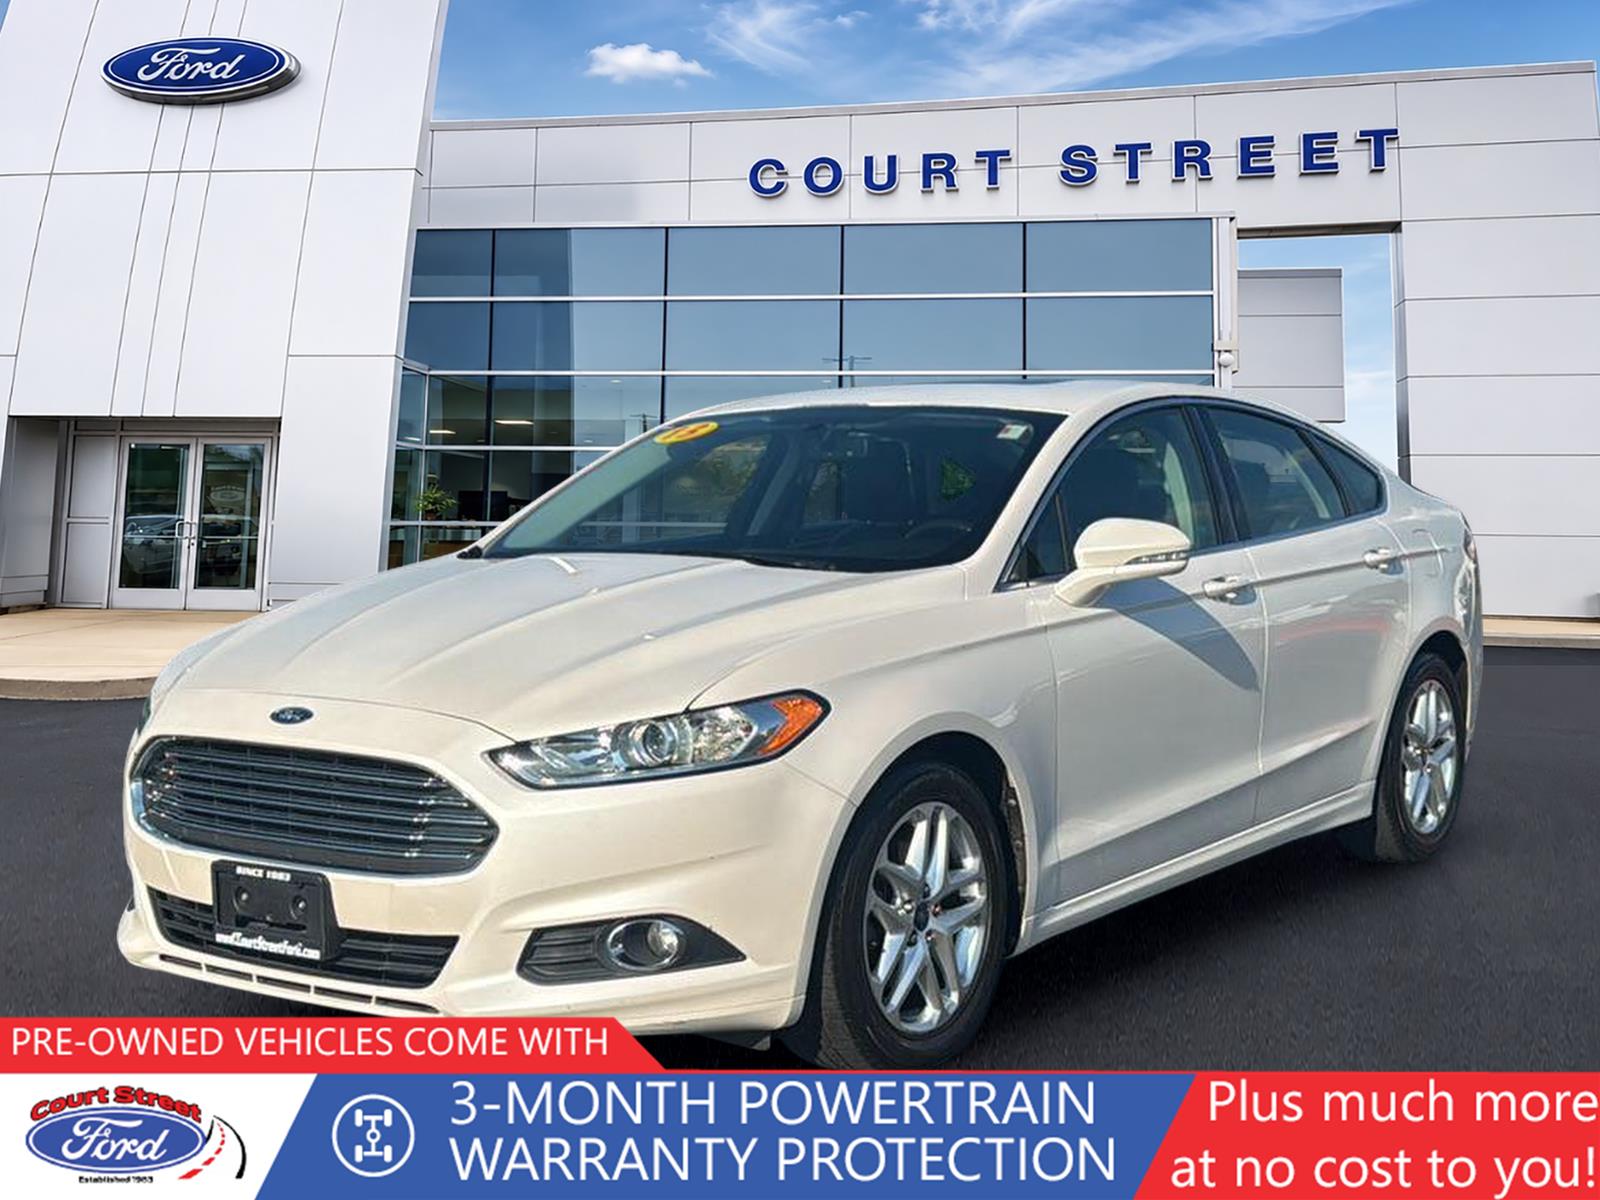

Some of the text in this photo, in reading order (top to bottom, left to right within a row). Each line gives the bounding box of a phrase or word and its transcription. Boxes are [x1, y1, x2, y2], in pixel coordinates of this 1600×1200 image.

[137, 47, 246, 81] Ford
[748, 127, 1400, 198] COURT STREET
